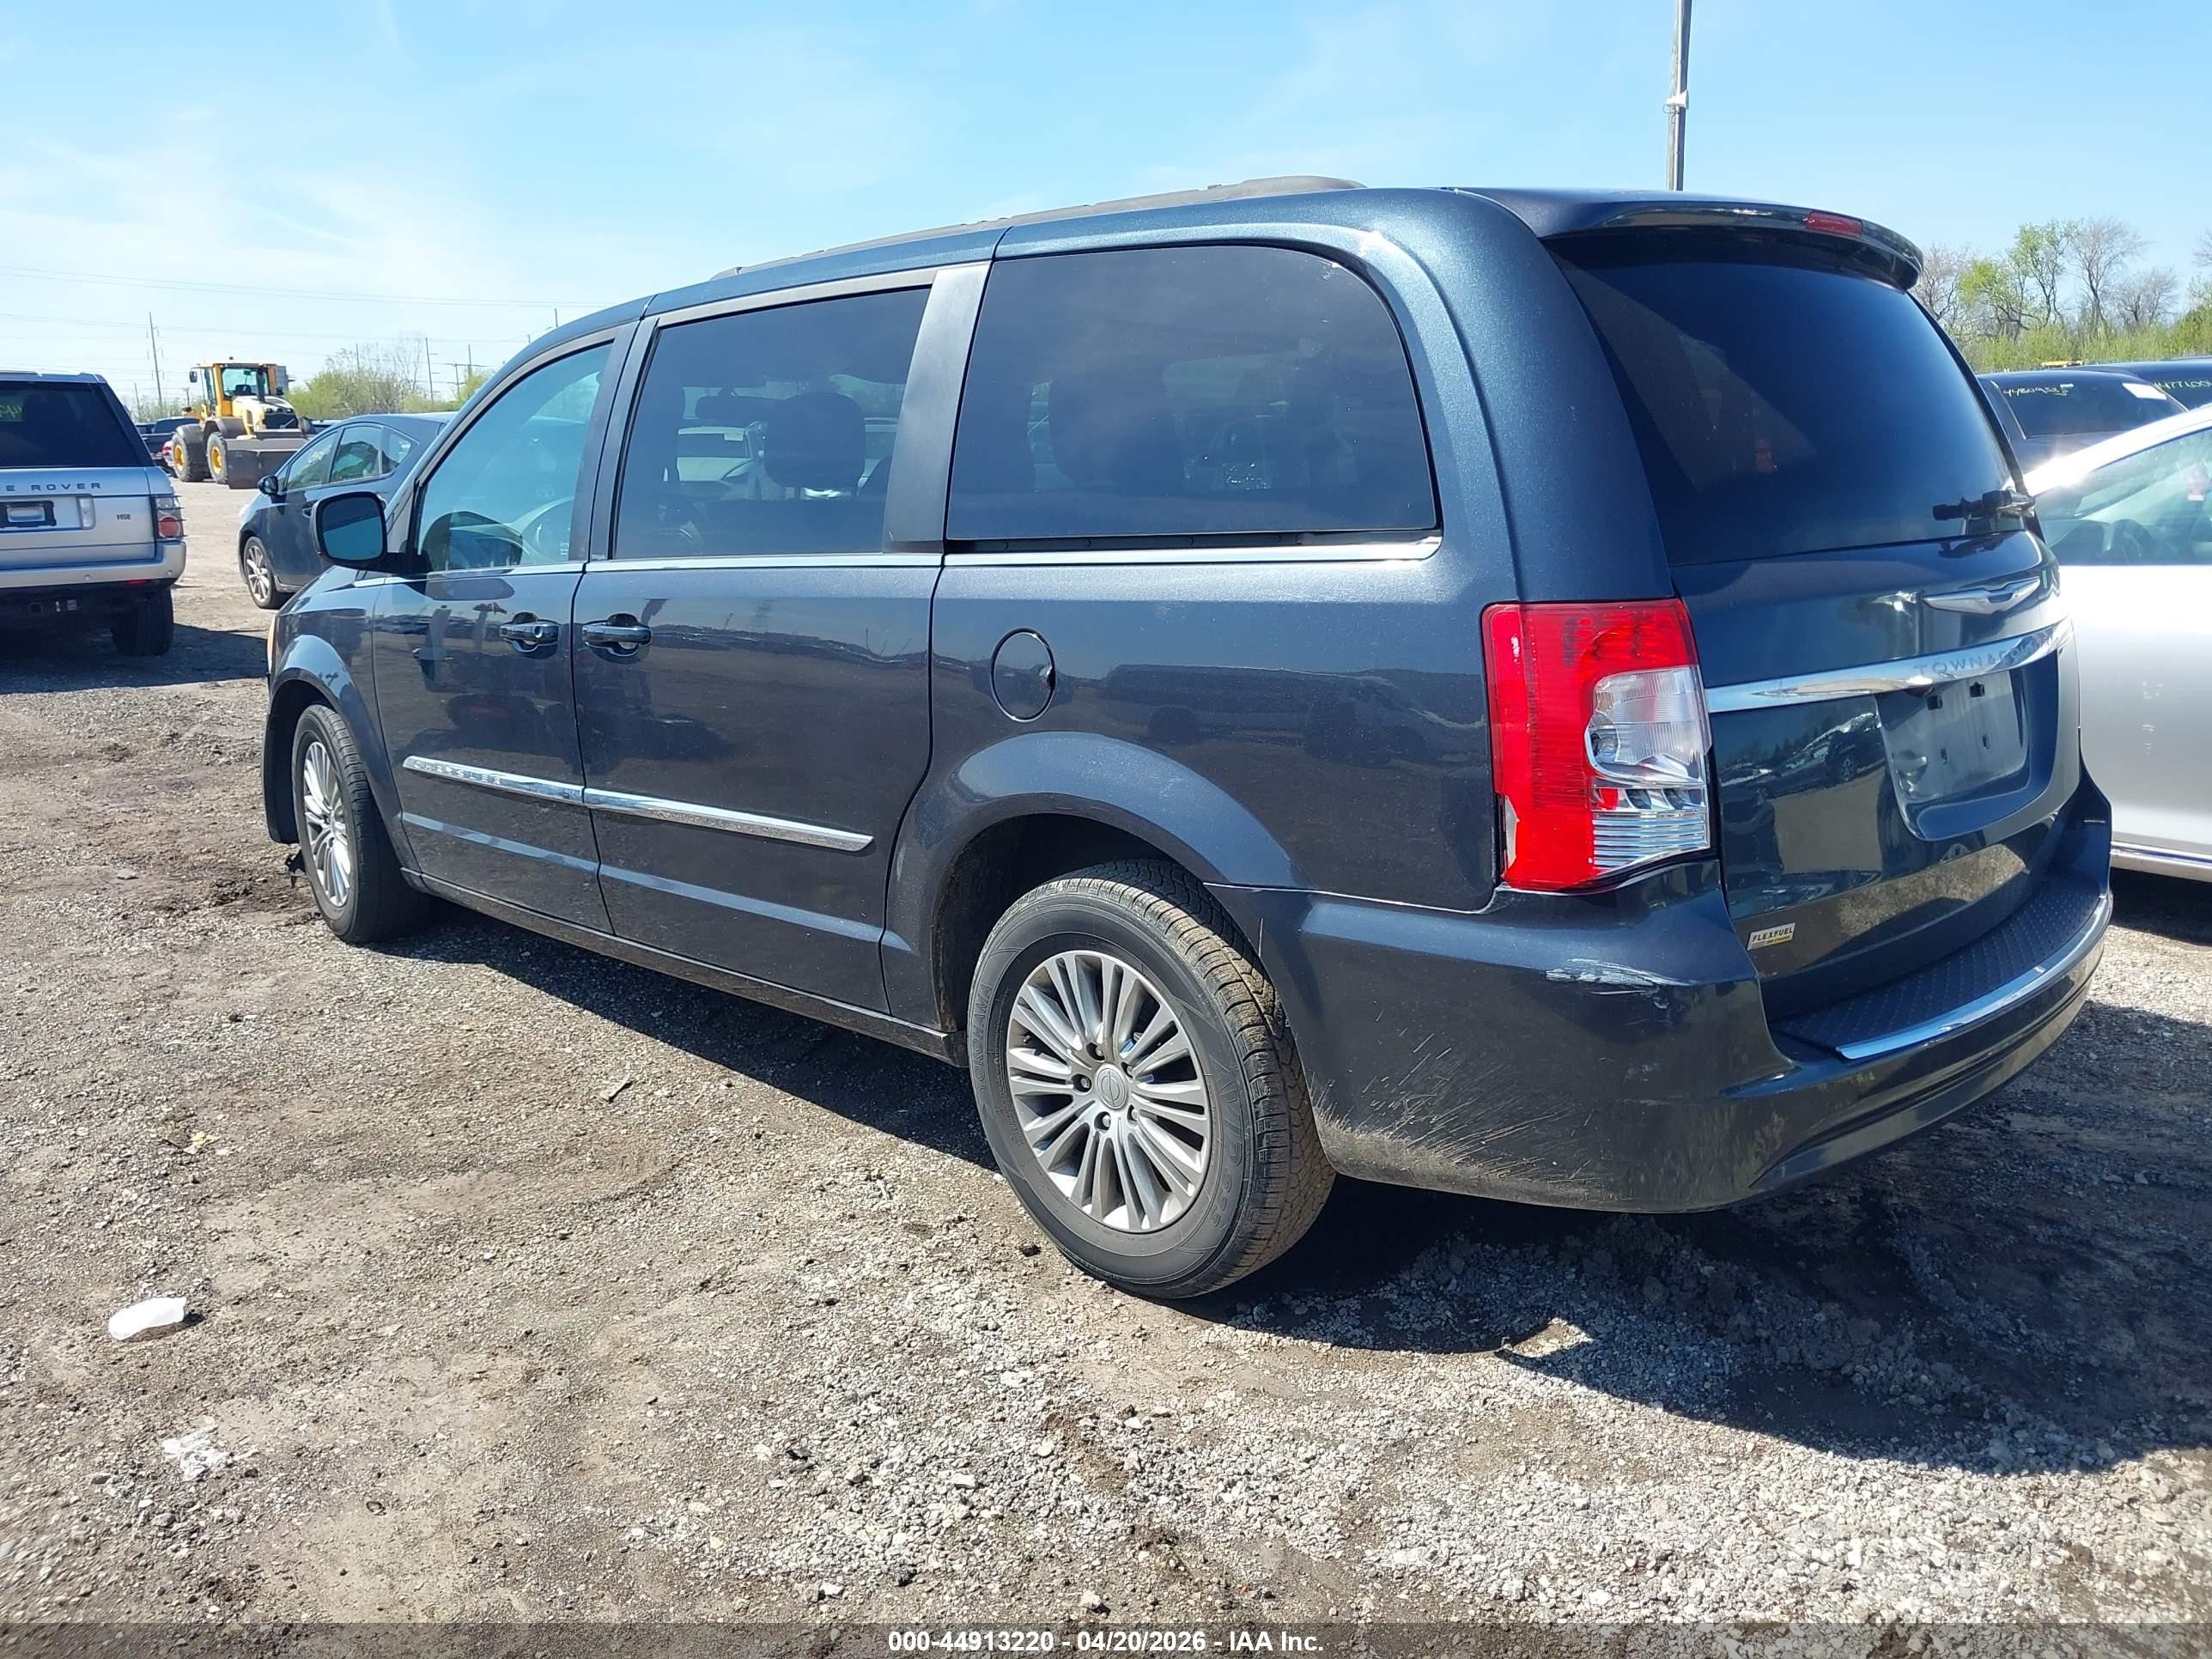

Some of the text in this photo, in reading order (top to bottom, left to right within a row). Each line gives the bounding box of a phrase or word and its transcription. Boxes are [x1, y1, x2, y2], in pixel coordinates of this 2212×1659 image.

[31, 483, 101, 491] ROVER
[1913, 655, 1983, 677] TOWN
[414, 761, 501, 784] CHRYSLER
[1753, 927, 1793, 942] FLEXFUEL
[972, 982, 993, 1091] YOKOHAMA
